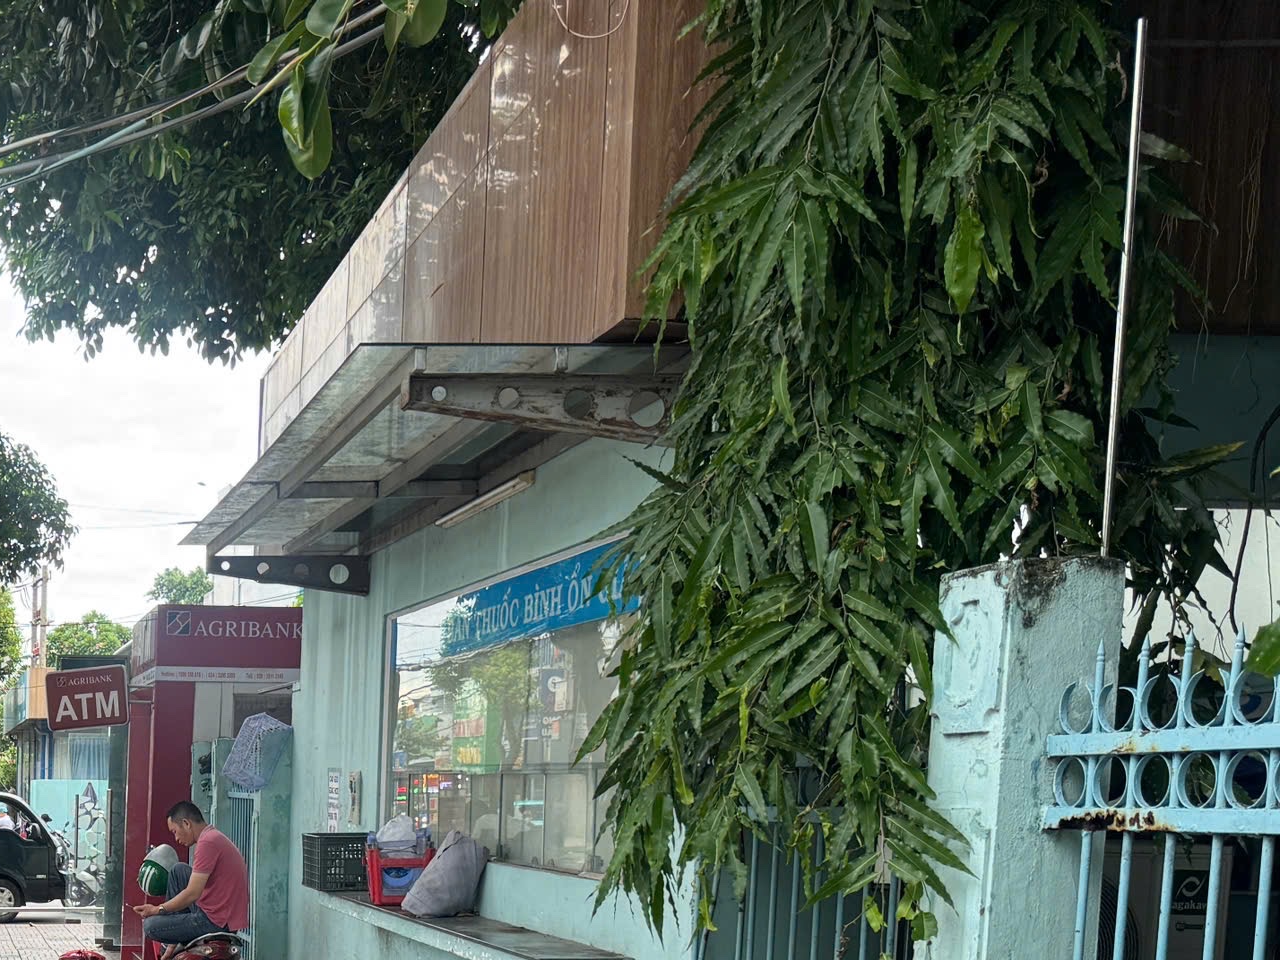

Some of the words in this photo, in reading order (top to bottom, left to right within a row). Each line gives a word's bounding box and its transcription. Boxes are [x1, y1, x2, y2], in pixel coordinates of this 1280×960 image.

[474, 587, 520, 636] THUỐC
[524, 583, 563, 624] BÌNH
[194, 620, 303, 639] AGRIBANK
[68, 674, 113, 686] AGRIBANK
[55, 690, 121, 723] ATM
